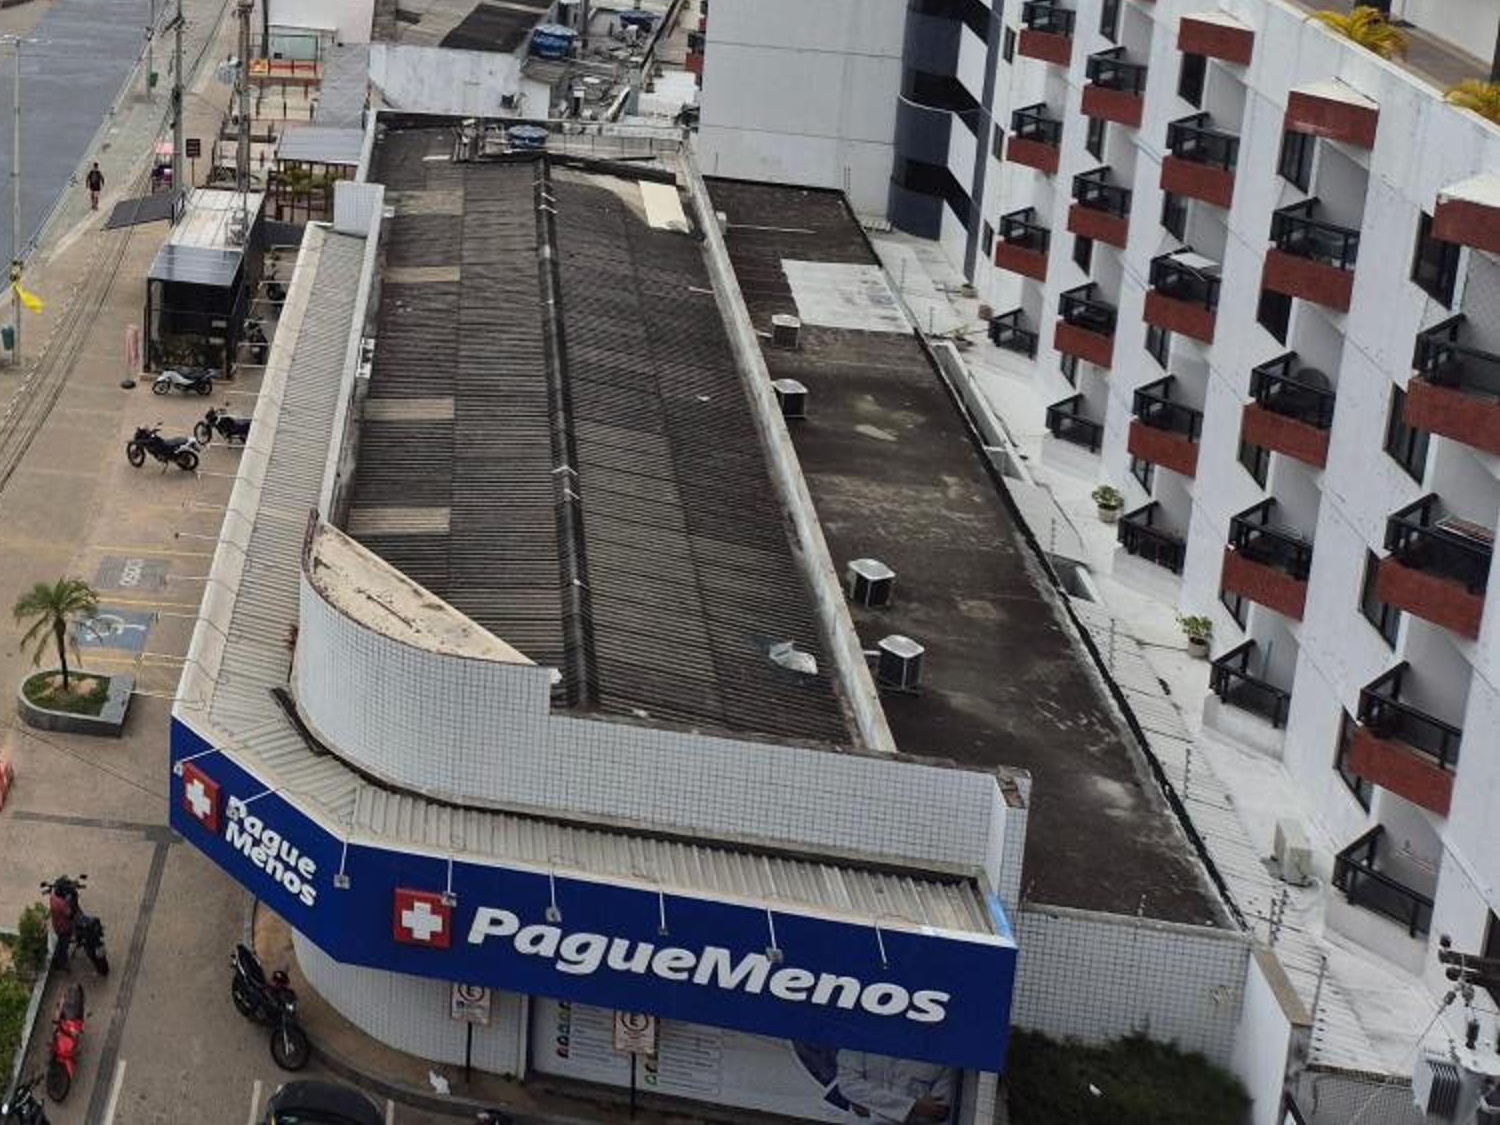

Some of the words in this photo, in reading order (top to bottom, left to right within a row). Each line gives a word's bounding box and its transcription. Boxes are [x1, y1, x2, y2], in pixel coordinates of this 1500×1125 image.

[225, 795, 318, 880] Pague
[225, 821, 318, 907] Menos
[467, 906, 951, 1023] PagueMenos
